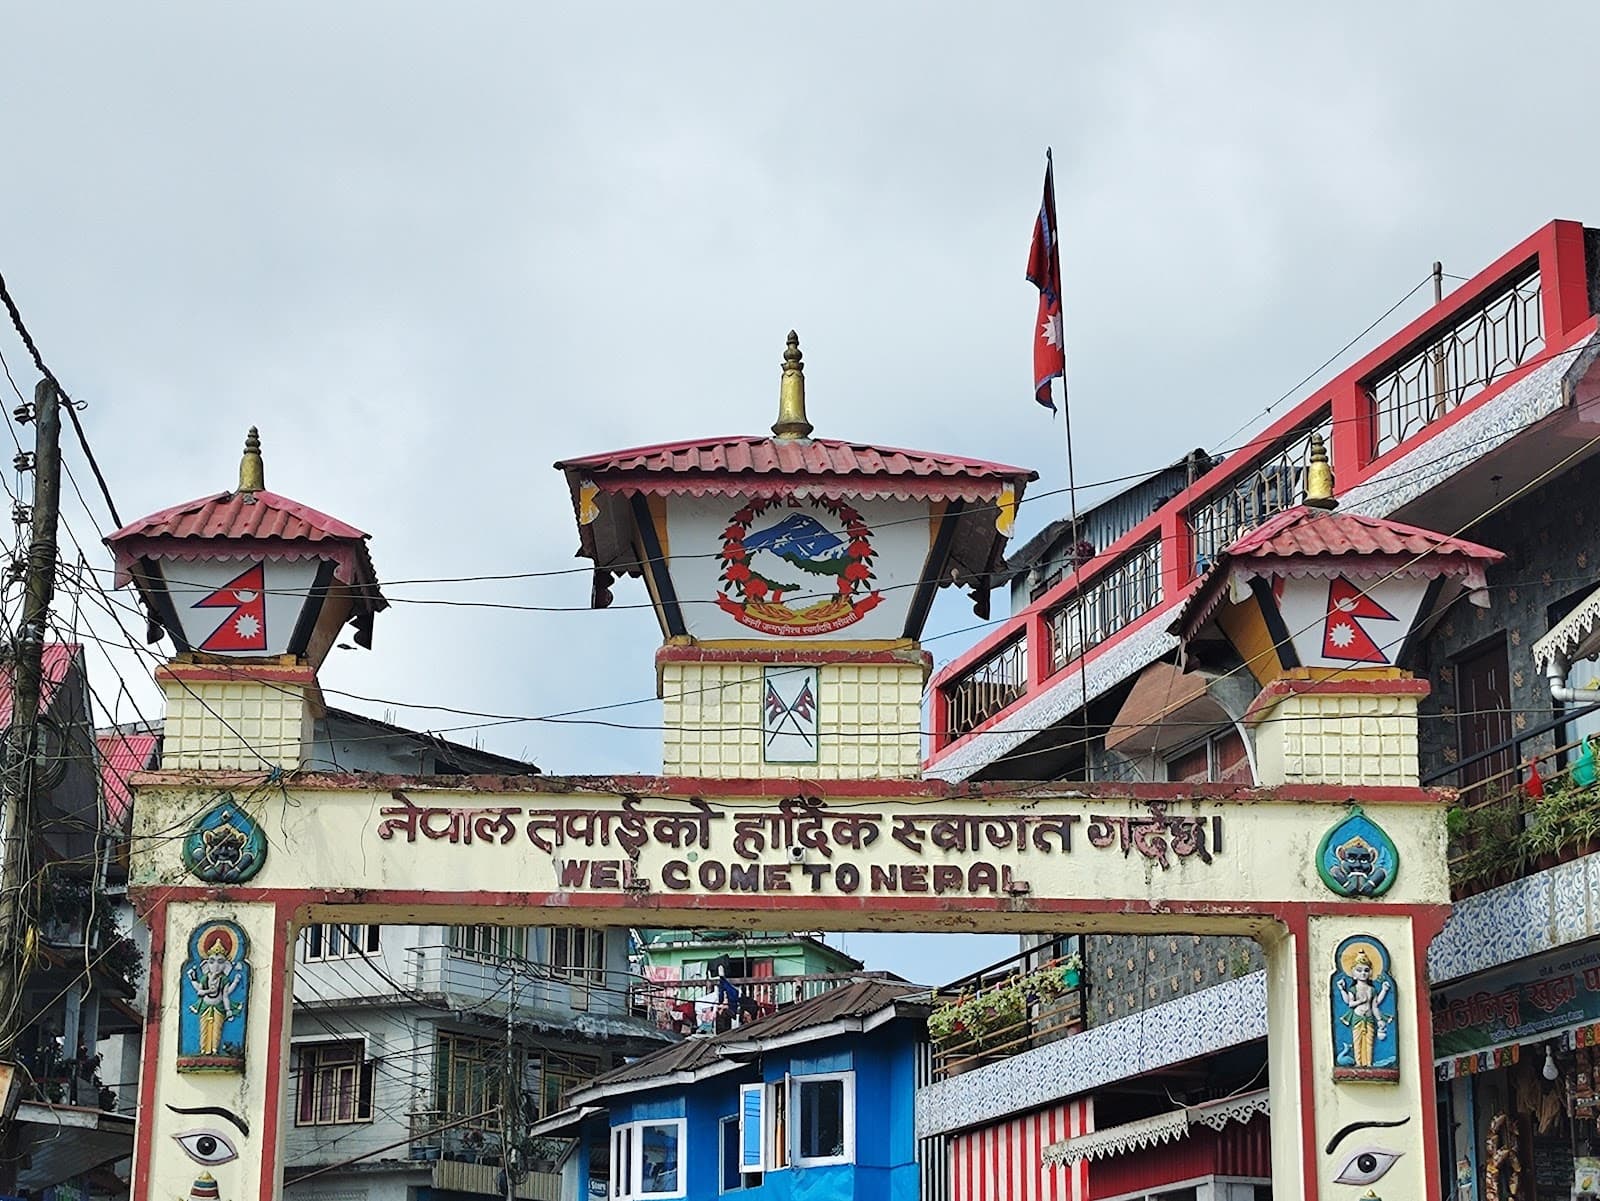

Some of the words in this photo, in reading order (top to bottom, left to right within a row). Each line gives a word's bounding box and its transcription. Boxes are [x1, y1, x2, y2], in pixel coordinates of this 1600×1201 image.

[378, 790, 522, 846] नेपाल
[733, 796, 883, 861] हार्दिक
[892, 814, 1080, 855] स्वागत
[560, 859, 792, 891] WELCOME
[802, 862, 861, 893] TO
[870, 861, 1031, 896] NEPAL
